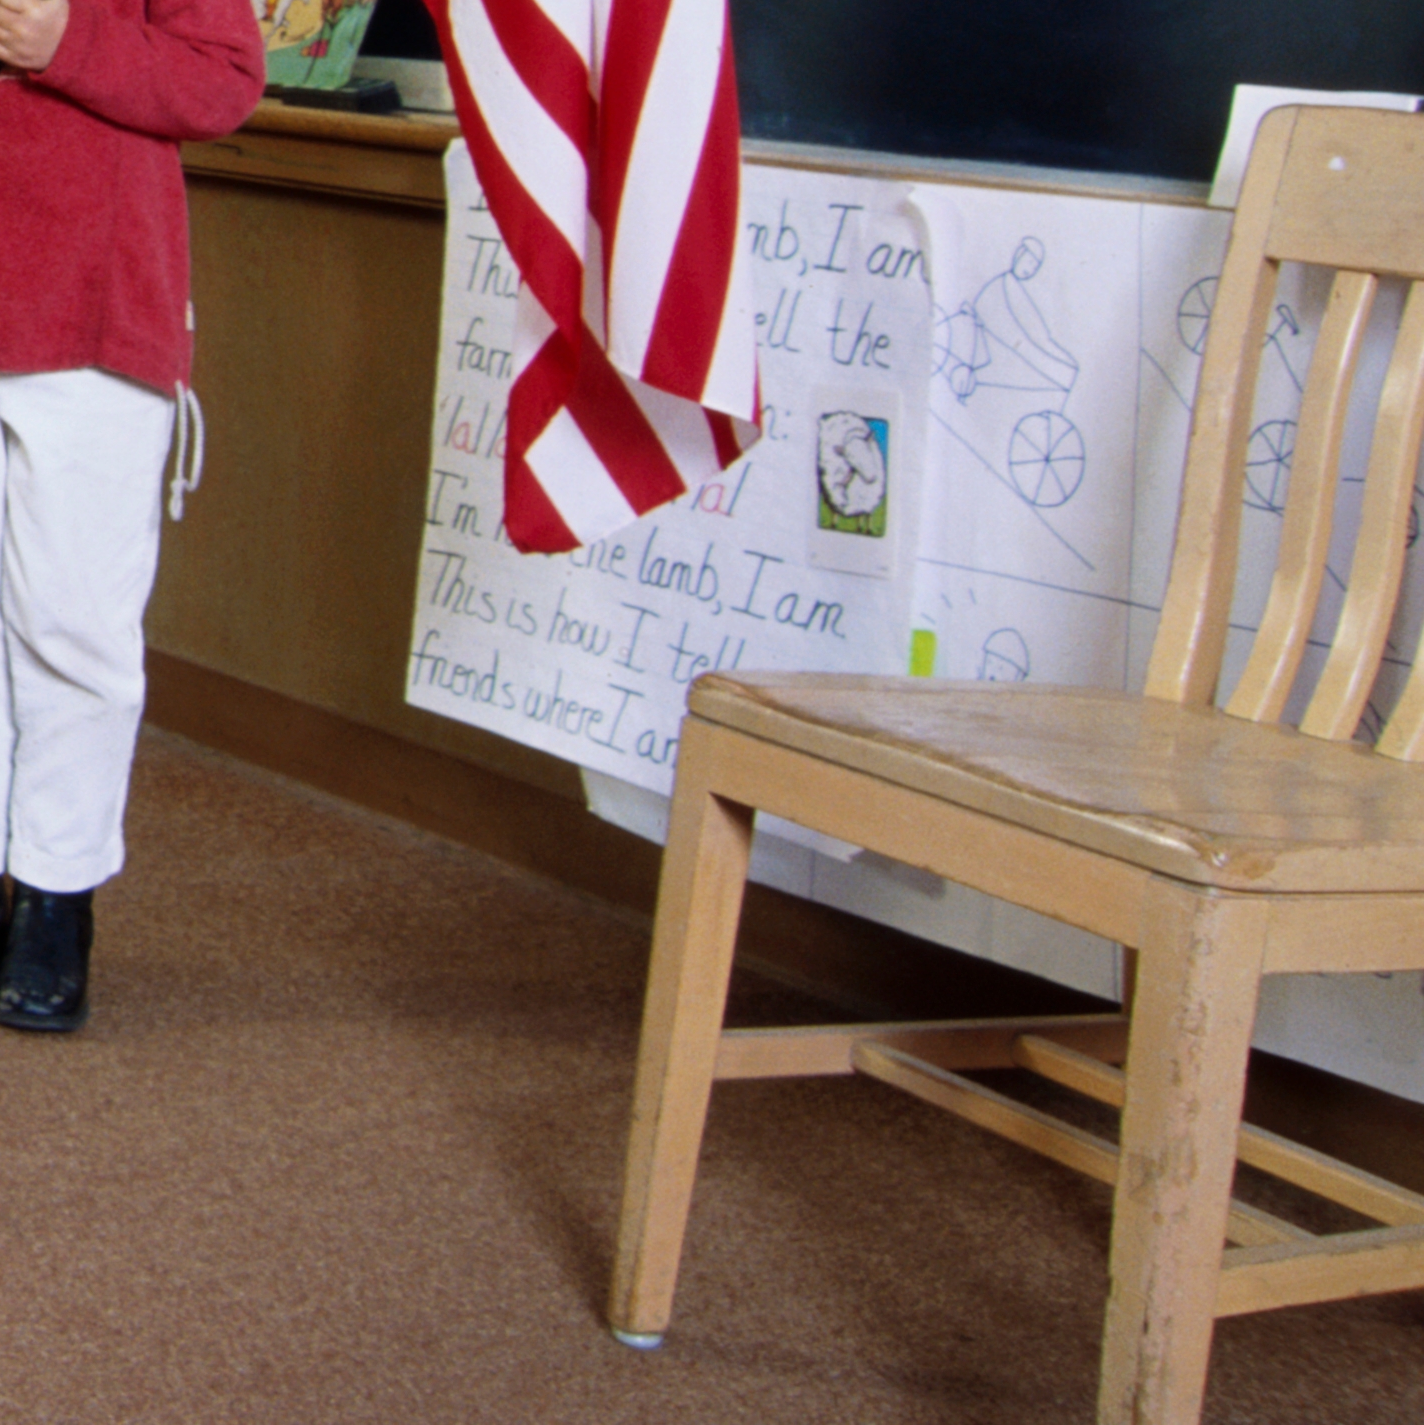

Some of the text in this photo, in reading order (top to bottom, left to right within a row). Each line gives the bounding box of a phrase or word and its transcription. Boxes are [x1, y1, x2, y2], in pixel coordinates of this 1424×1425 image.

[465, 233, 892, 370] Thi ell the
[811, 203, 865, 273] I
[866, 241, 933, 286] am
[425, 468, 483, 539] I'm
[729, 548, 786, 622] I
[774, 591, 847, 640] am
[426, 548, 497, 624] This
[505, 588, 538, 637] is
[547, 585, 612, 657] how
[612, 600, 662, 674] I
[409, 627, 517, 711] friends
[523, 667, 604, 736] where
[599, 682, 647, 755] I
